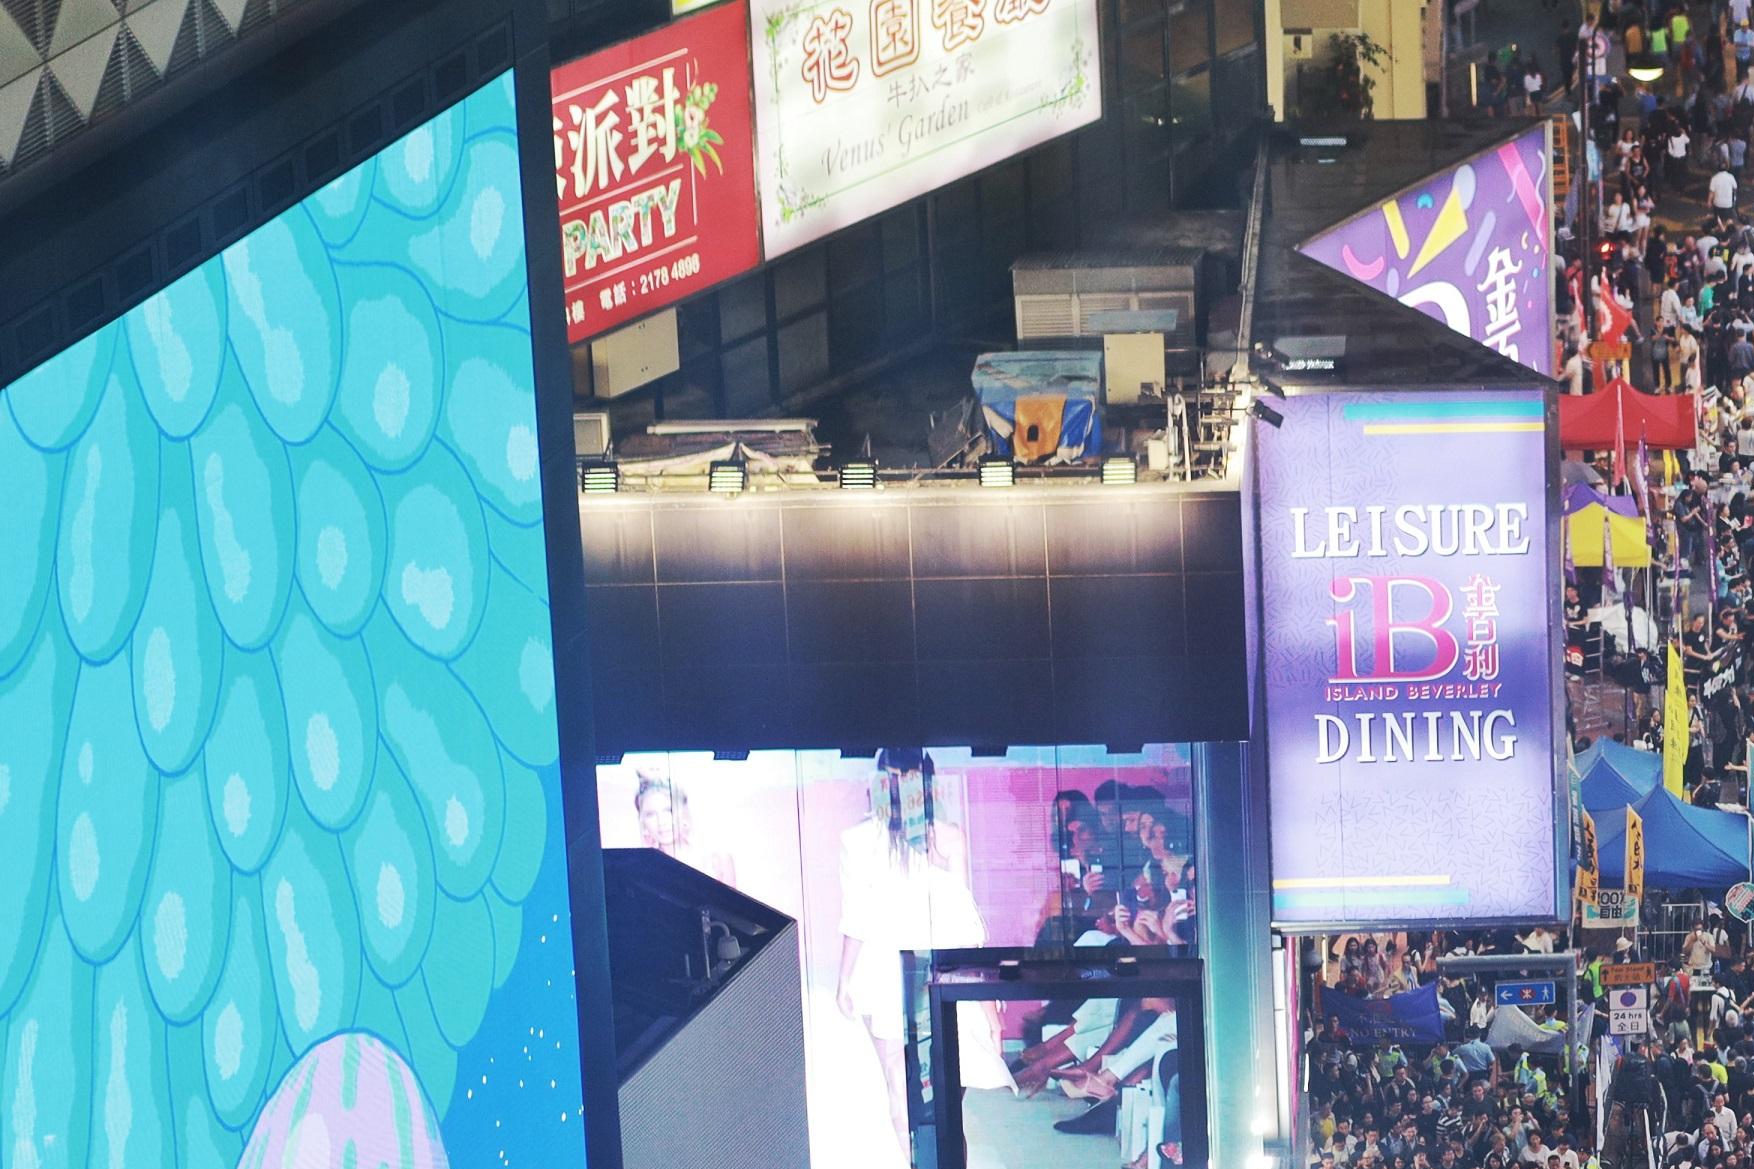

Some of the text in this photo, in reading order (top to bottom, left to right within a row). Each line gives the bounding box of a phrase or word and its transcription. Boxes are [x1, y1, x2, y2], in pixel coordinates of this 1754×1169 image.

[898, 95, 970, 157] Garden
[561, 178, 682, 277] PARTY
[1290, 503, 1531, 559] LEISURE
[1325, 683, 1502, 702] ISLAND BEVERLEY
[1314, 709, 1518, 765] DINING
[1614, 1011, 1642, 1020] 24 hrs
[1616, 1022, 1640, 1032] 全日
